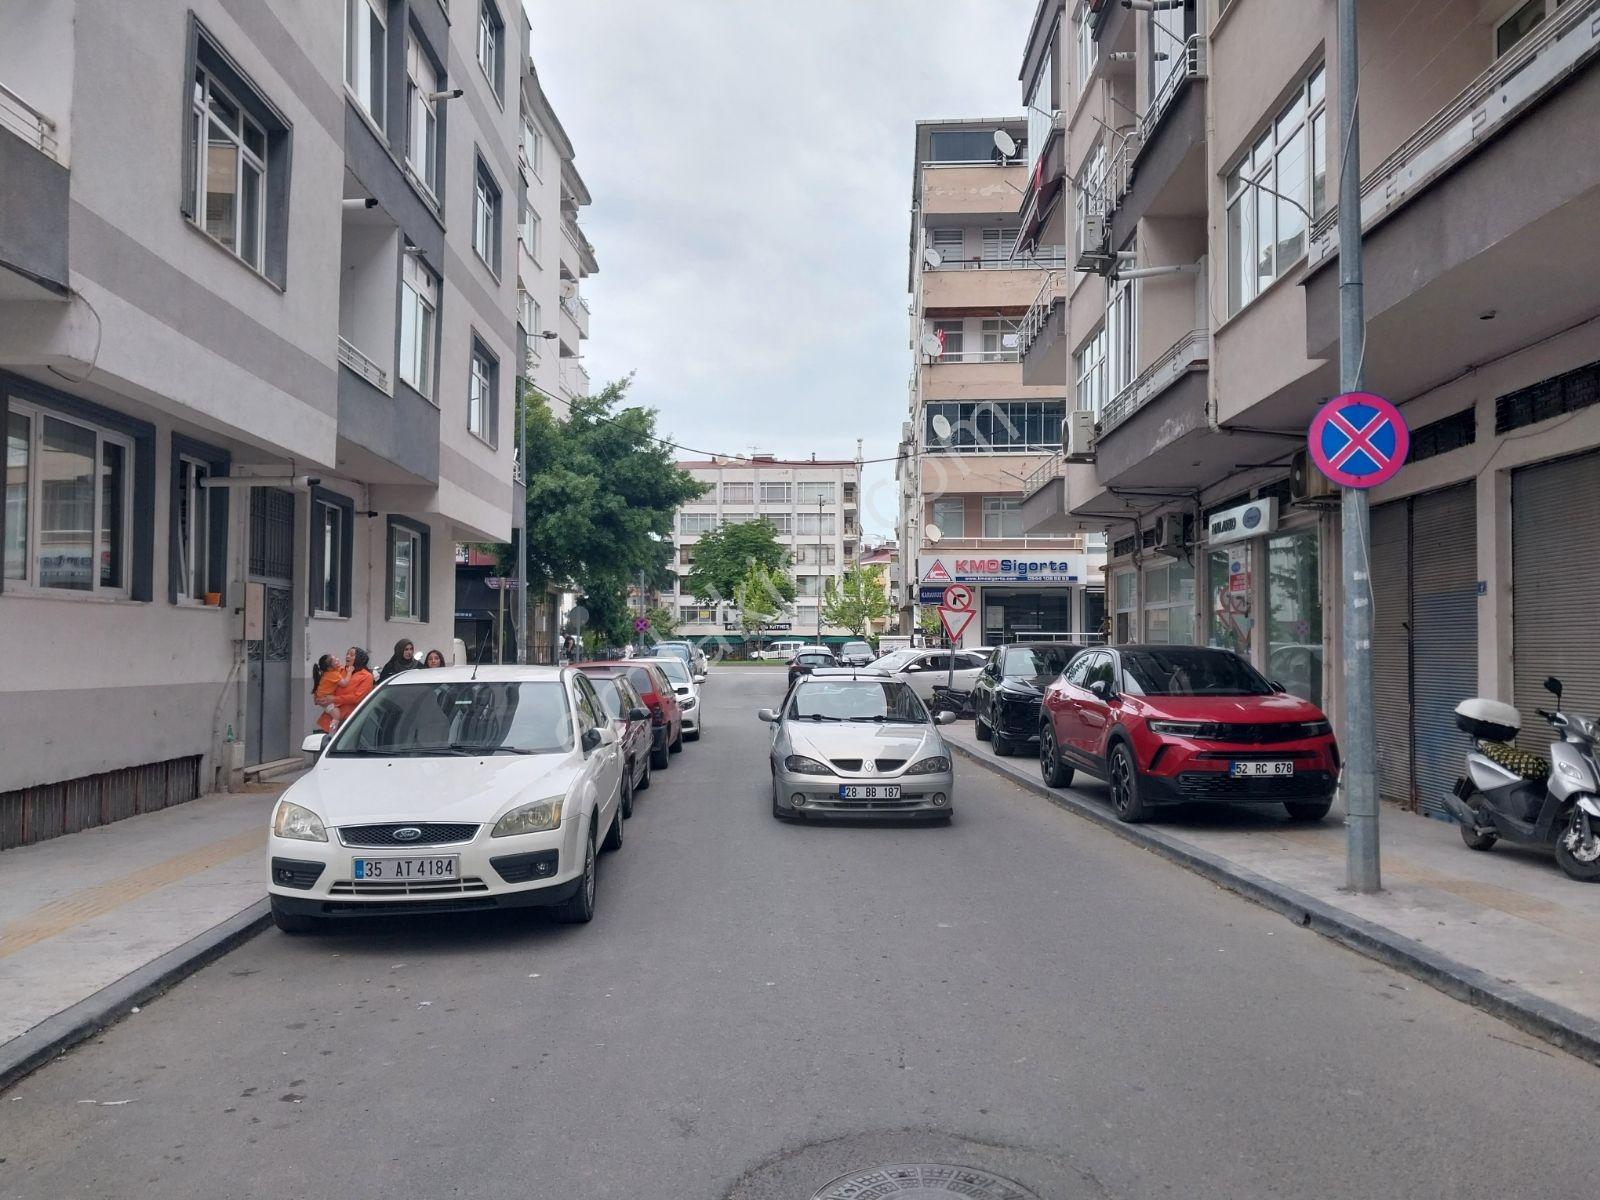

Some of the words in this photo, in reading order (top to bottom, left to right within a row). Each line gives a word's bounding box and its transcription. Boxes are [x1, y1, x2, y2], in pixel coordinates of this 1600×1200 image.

[1236, 763, 1247, 774] 52
[1255, 763, 1268, 774] RC
[846, 787, 857, 797] 28
[865, 787, 877, 797] BB
[884, 787, 899, 797] 187
[365, 862, 382, 877] 35
